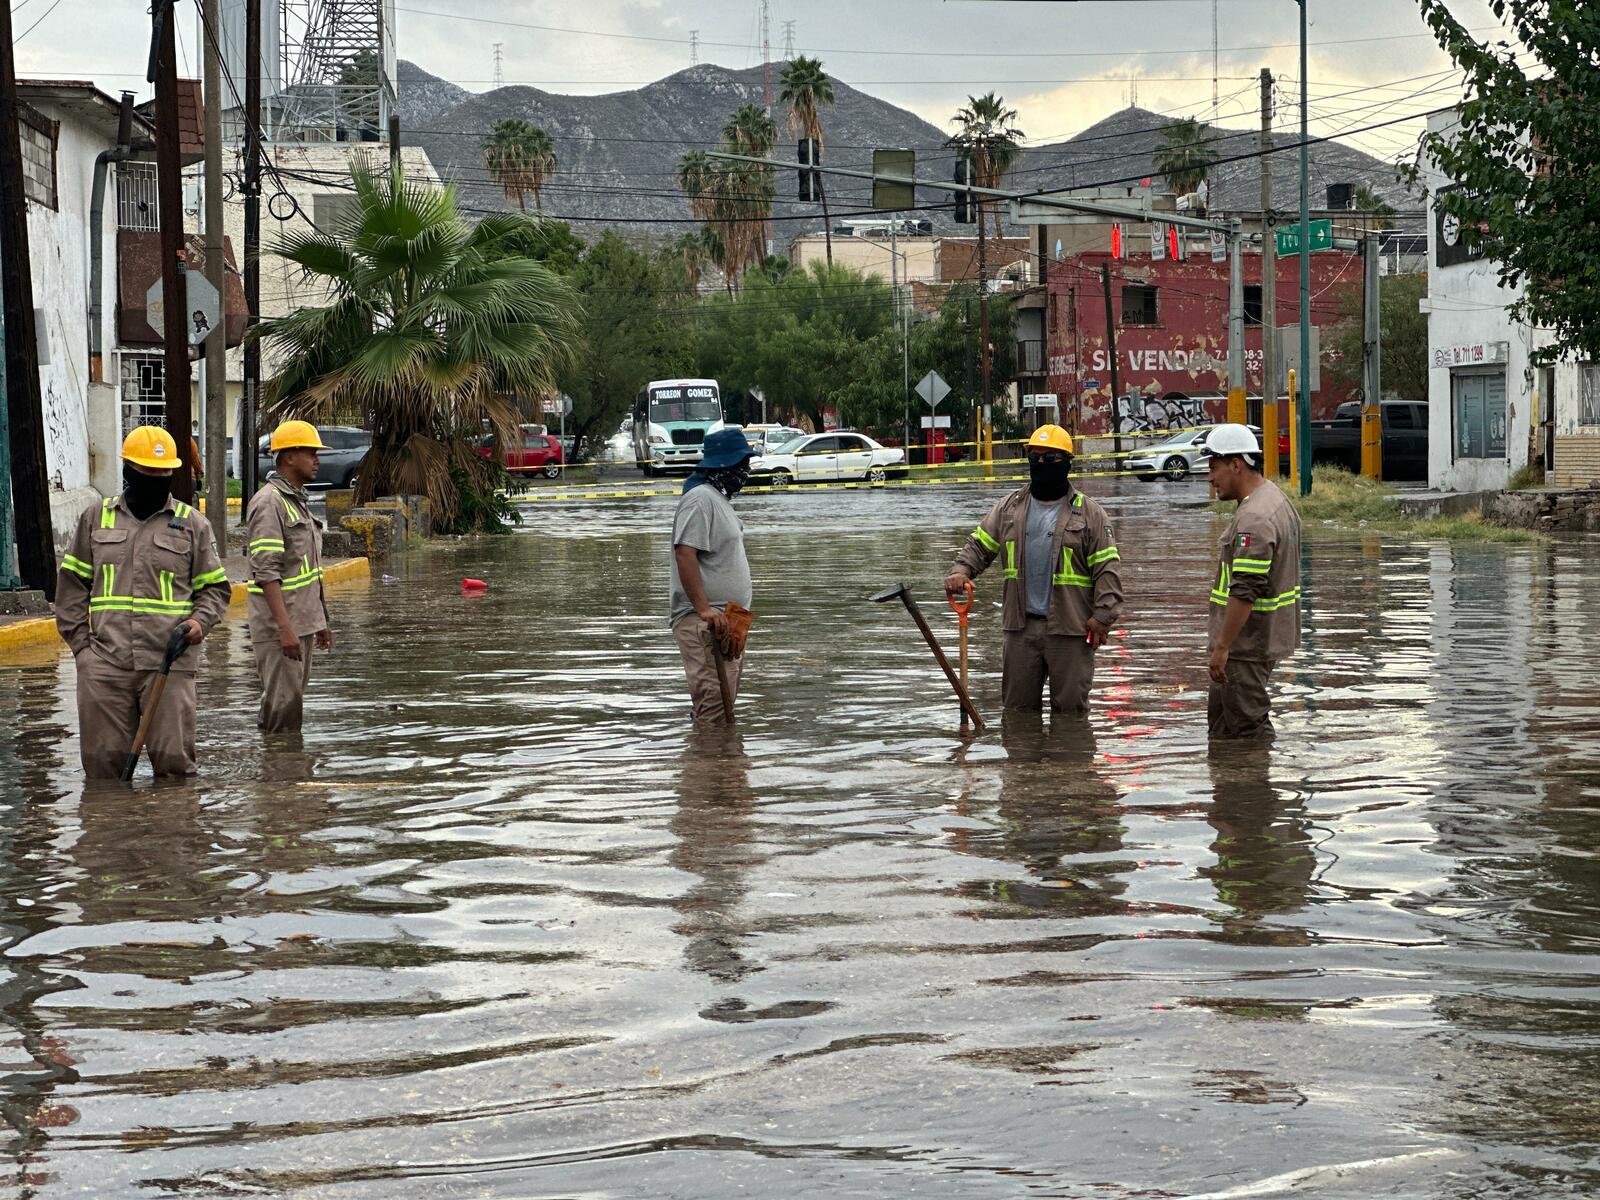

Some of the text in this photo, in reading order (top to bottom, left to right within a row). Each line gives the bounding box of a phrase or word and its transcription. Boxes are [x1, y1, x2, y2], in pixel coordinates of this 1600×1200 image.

[1462, 346, 1471, 363] 711
[1471, 343, 1483, 361] 1299
[655, 388, 713, 399] TORREON GOMEZ
